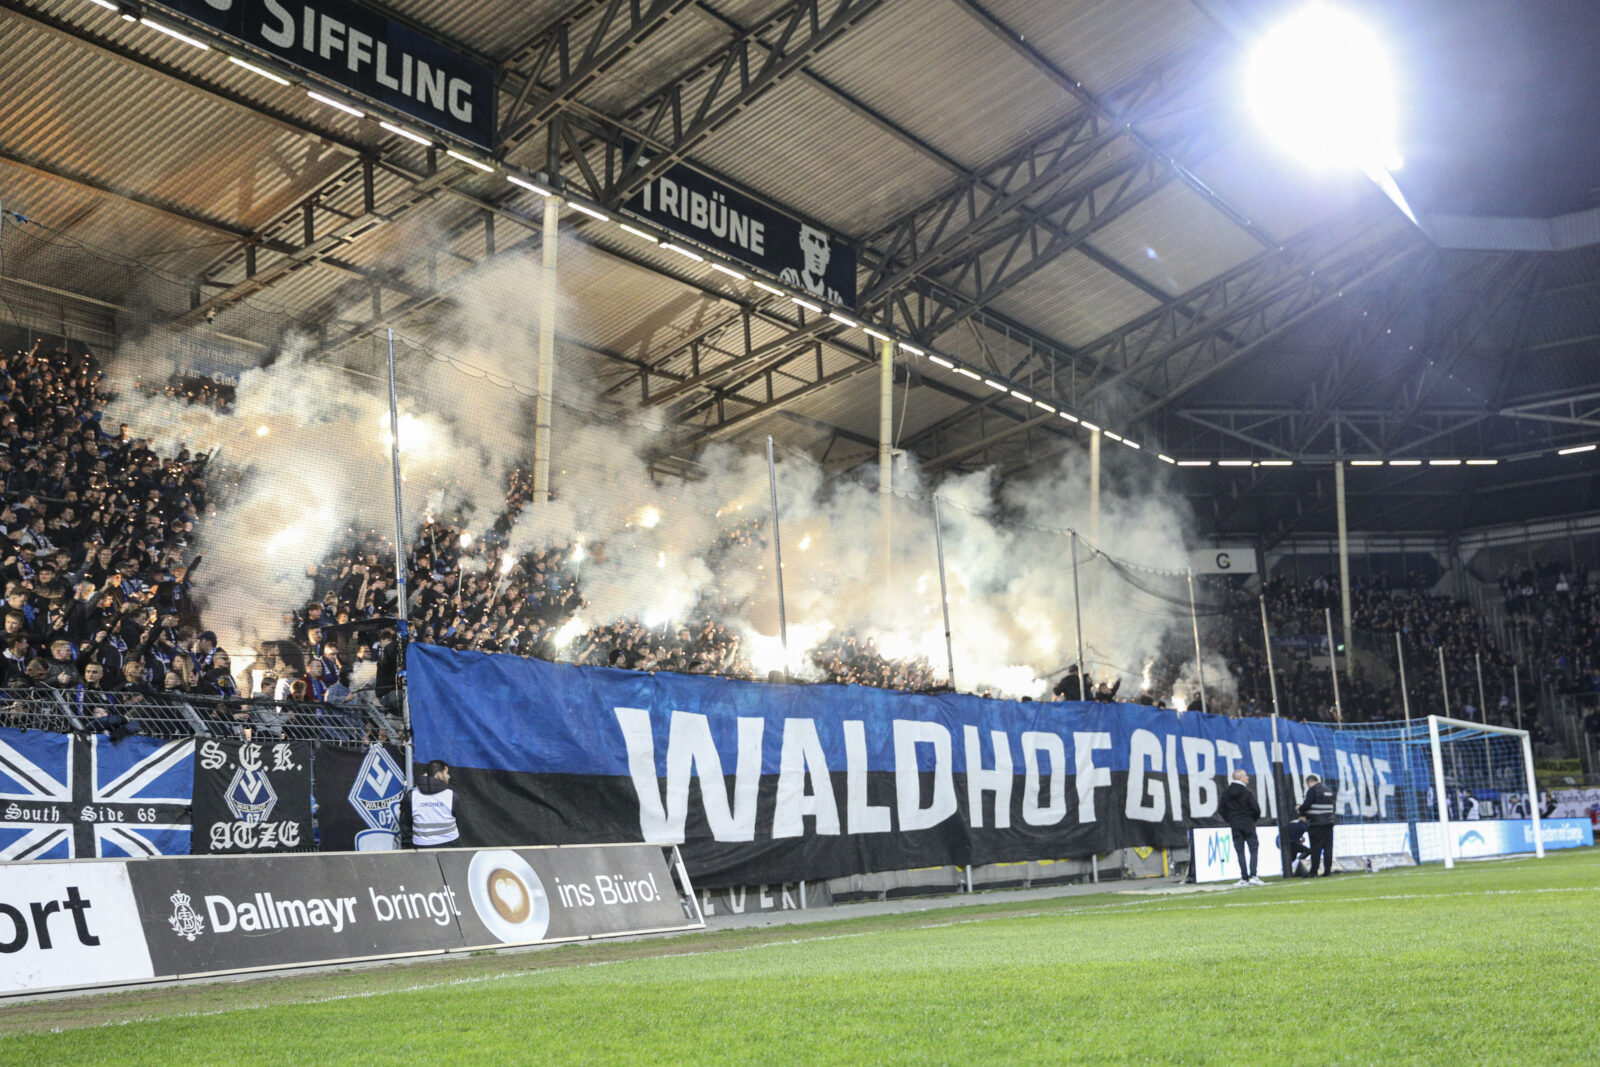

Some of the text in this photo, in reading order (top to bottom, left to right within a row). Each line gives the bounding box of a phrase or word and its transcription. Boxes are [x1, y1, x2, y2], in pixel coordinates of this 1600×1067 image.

[261, 0, 473, 123] SIFFLING
[1216, 553, 1231, 569] G
[614, 707, 1112, 843] WALDHOF
[1125, 728, 1243, 823] GIBT
[1335, 750, 1395, 818] AUF
[4, 803, 157, 823] South Side 68
[204, 872, 661, 934] Dallmayr bringt ins Büro!
